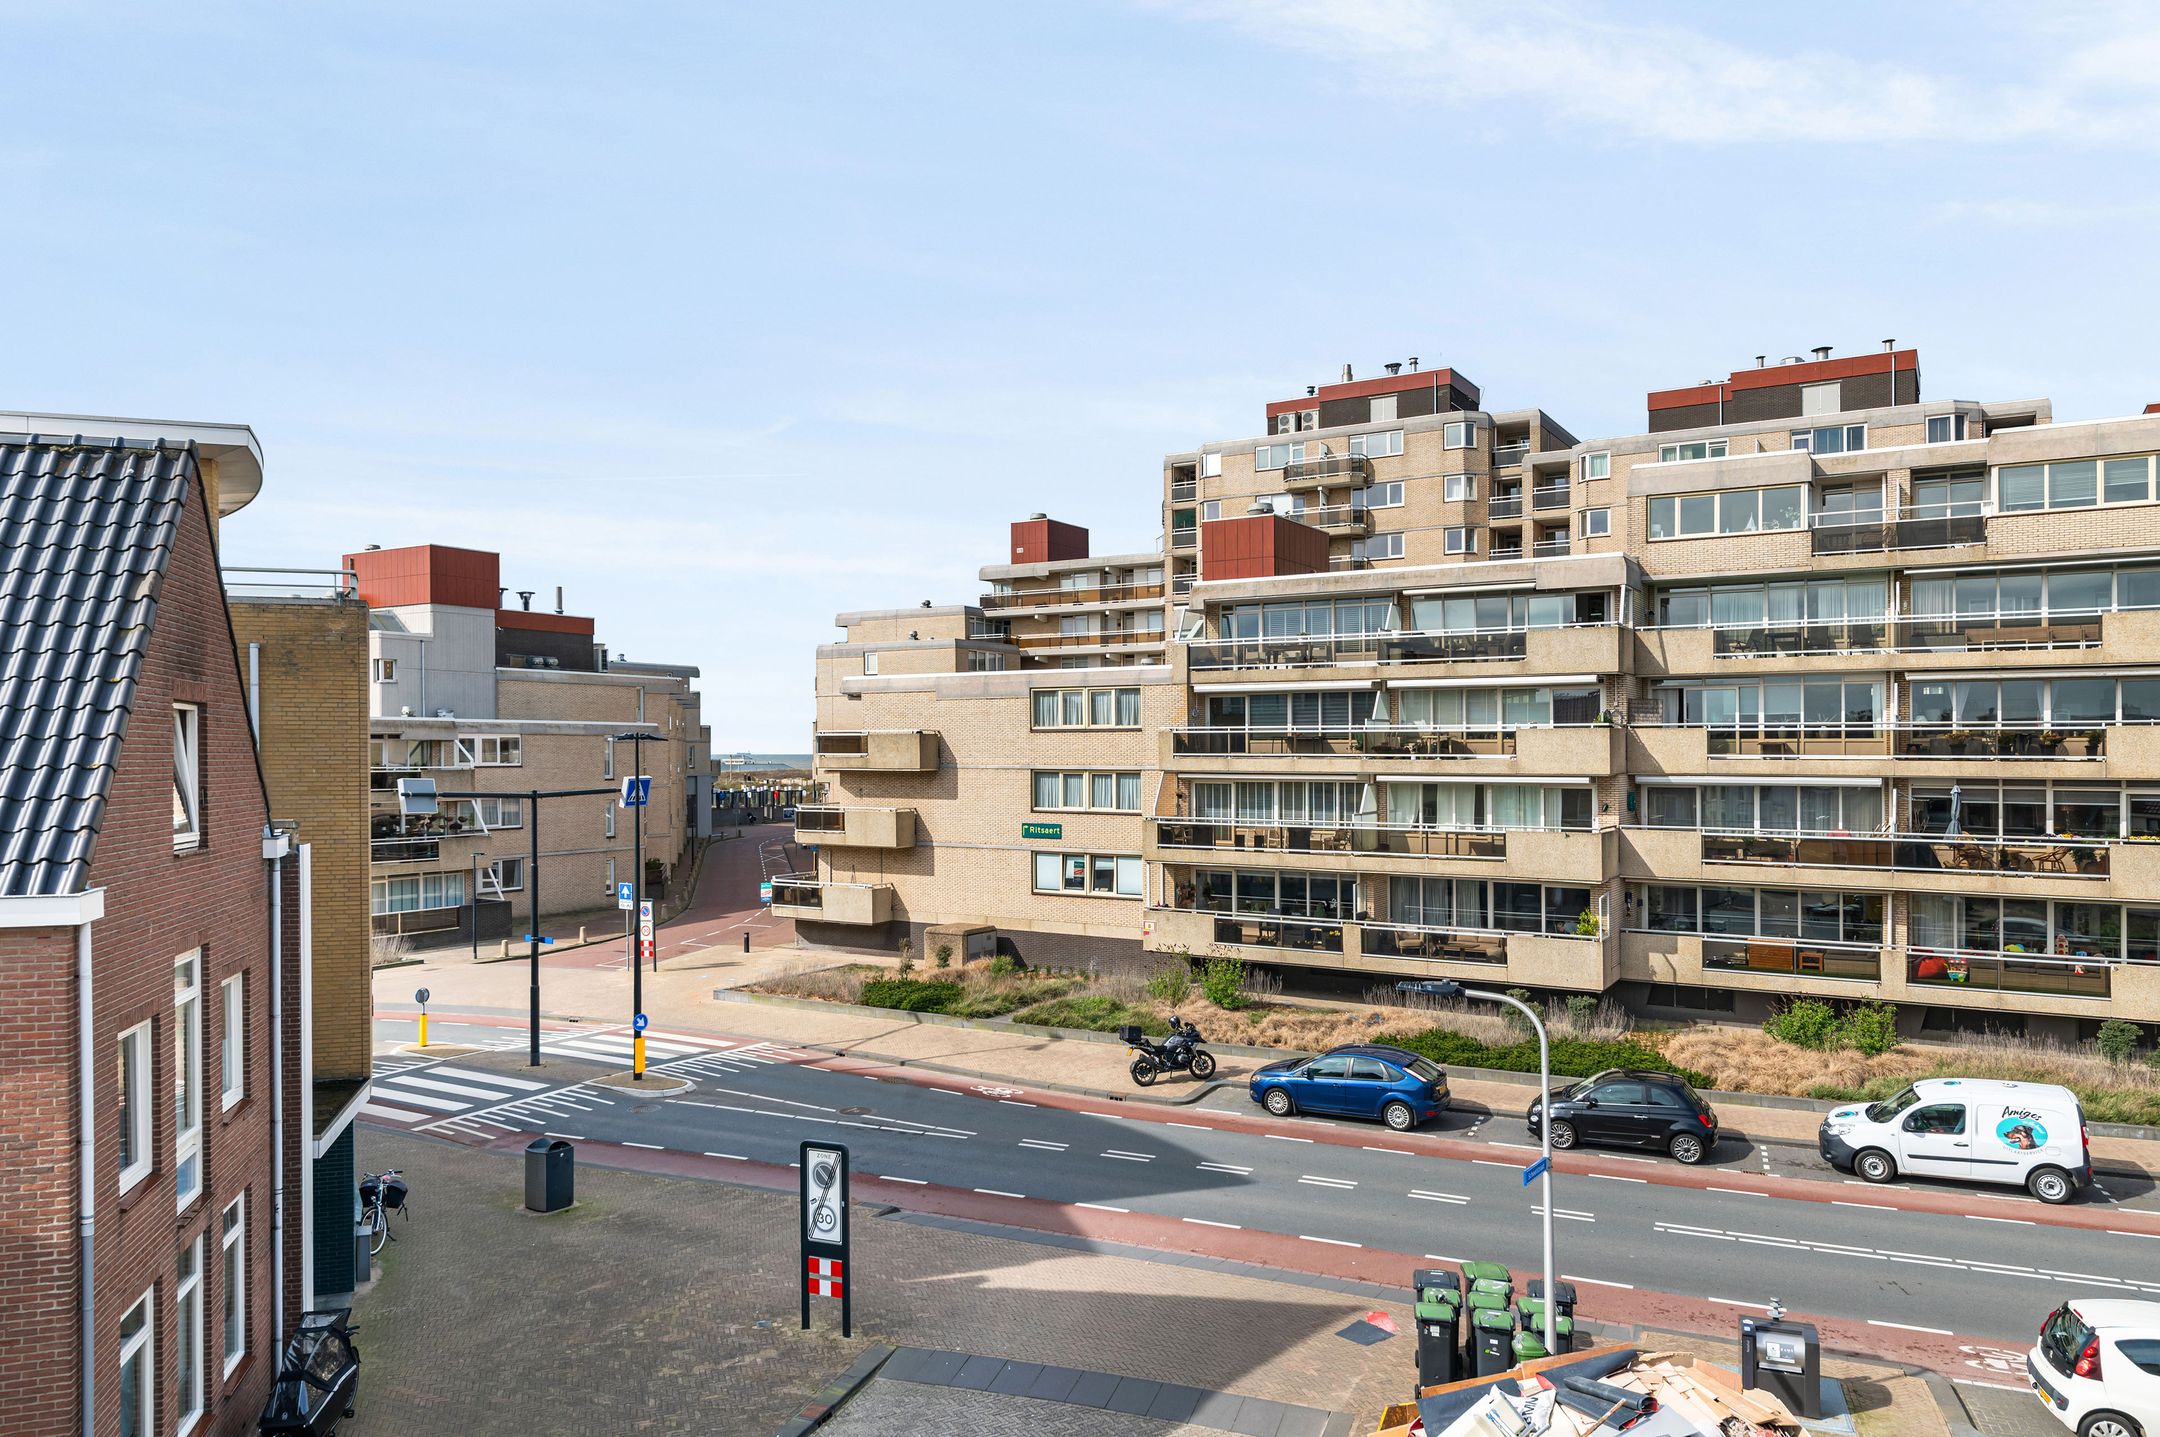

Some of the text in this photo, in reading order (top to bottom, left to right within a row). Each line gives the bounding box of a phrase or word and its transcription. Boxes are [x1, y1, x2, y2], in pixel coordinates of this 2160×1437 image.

[1029, 826, 1060, 834] Ritsaert
[2002, 1106, 2042, 1120] Amigos
[817, 1214, 833, 1224] 30
